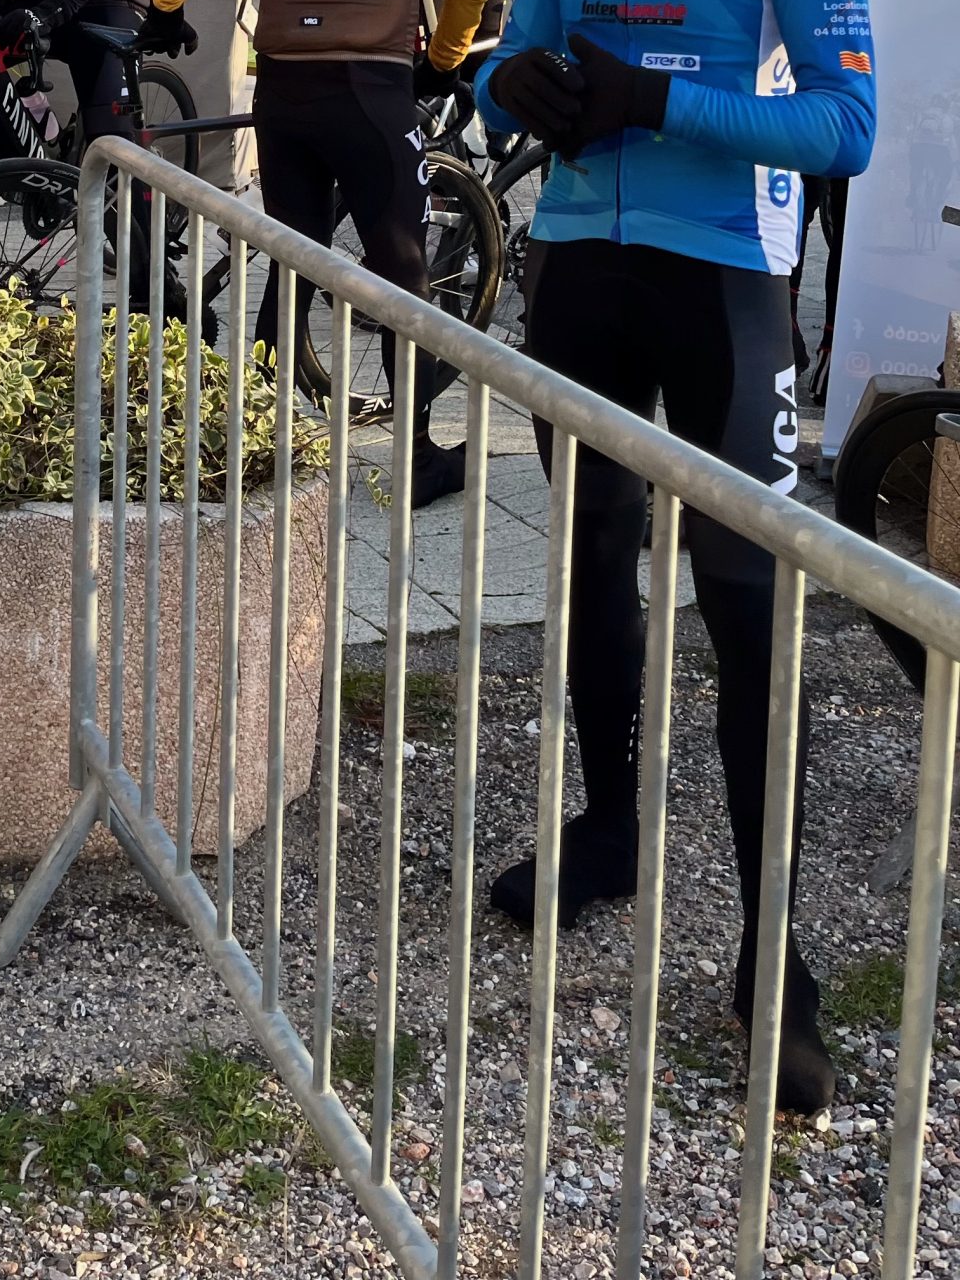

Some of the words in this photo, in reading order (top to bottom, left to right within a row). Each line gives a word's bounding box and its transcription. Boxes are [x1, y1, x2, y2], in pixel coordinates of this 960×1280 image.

[830, 13, 845, 23] de
[813, 27, 829, 36] 04
[831, 26, 847, 36] 68
[771, 364, 799, 496] VCA
